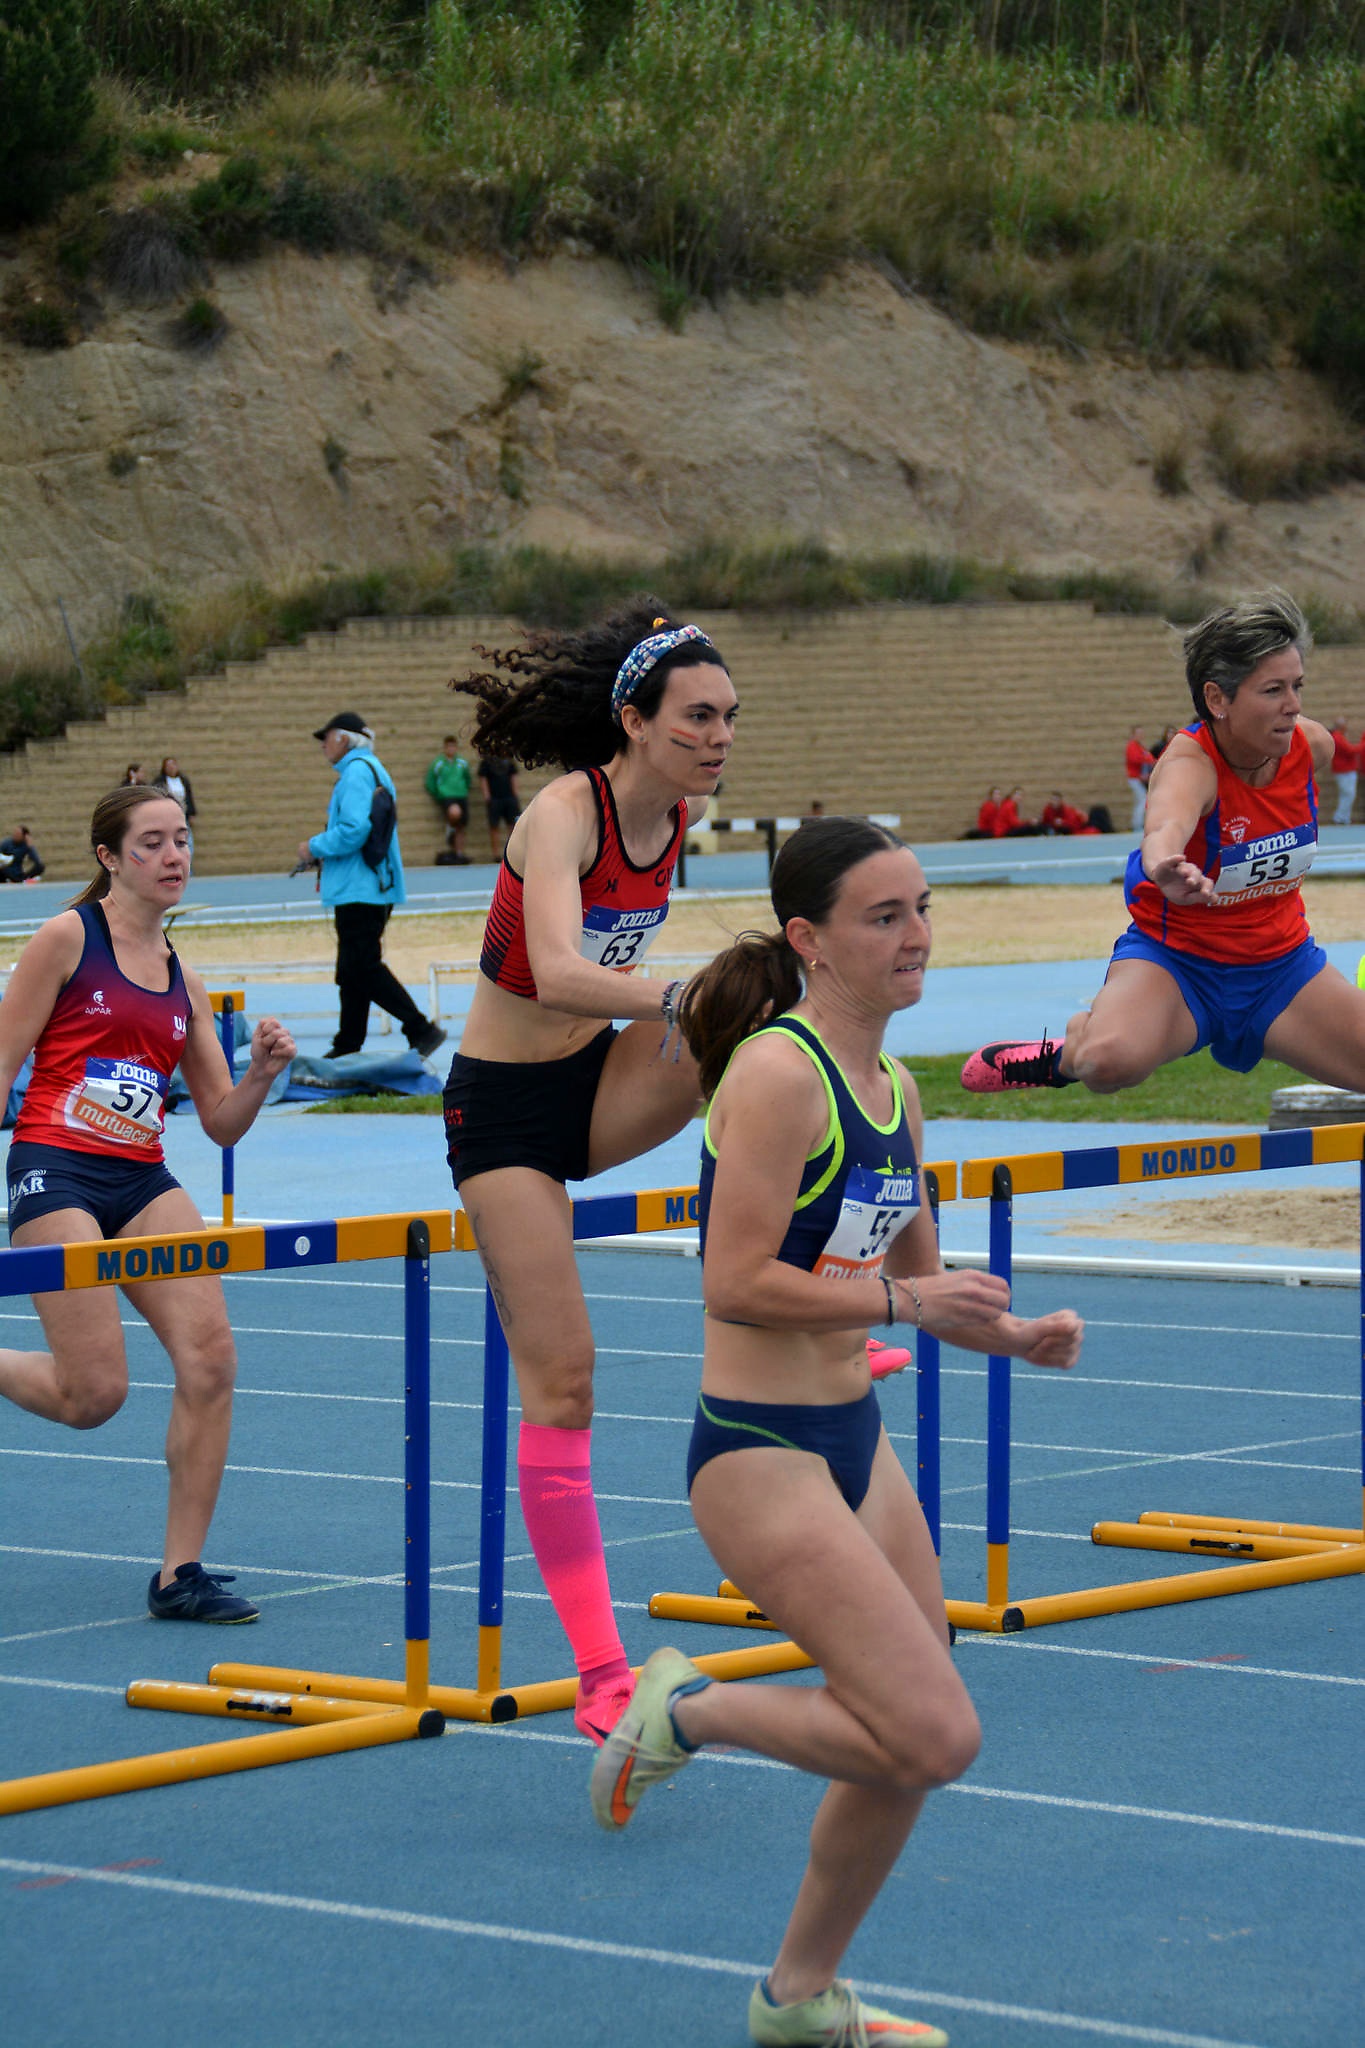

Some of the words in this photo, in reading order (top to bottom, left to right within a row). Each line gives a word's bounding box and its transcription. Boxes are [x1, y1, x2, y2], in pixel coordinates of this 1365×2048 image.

[1245, 831, 1298, 860] Joma
[1245, 853, 1290, 888] 53
[611, 909, 661, 931] Joma
[599, 931, 645, 967] 63
[111, 1062, 158, 1088] Joma
[111, 1083, 154, 1119] 57
[1142, 1143, 1236, 1177] MONDO
[97, 1240, 230, 1280] MONDO
